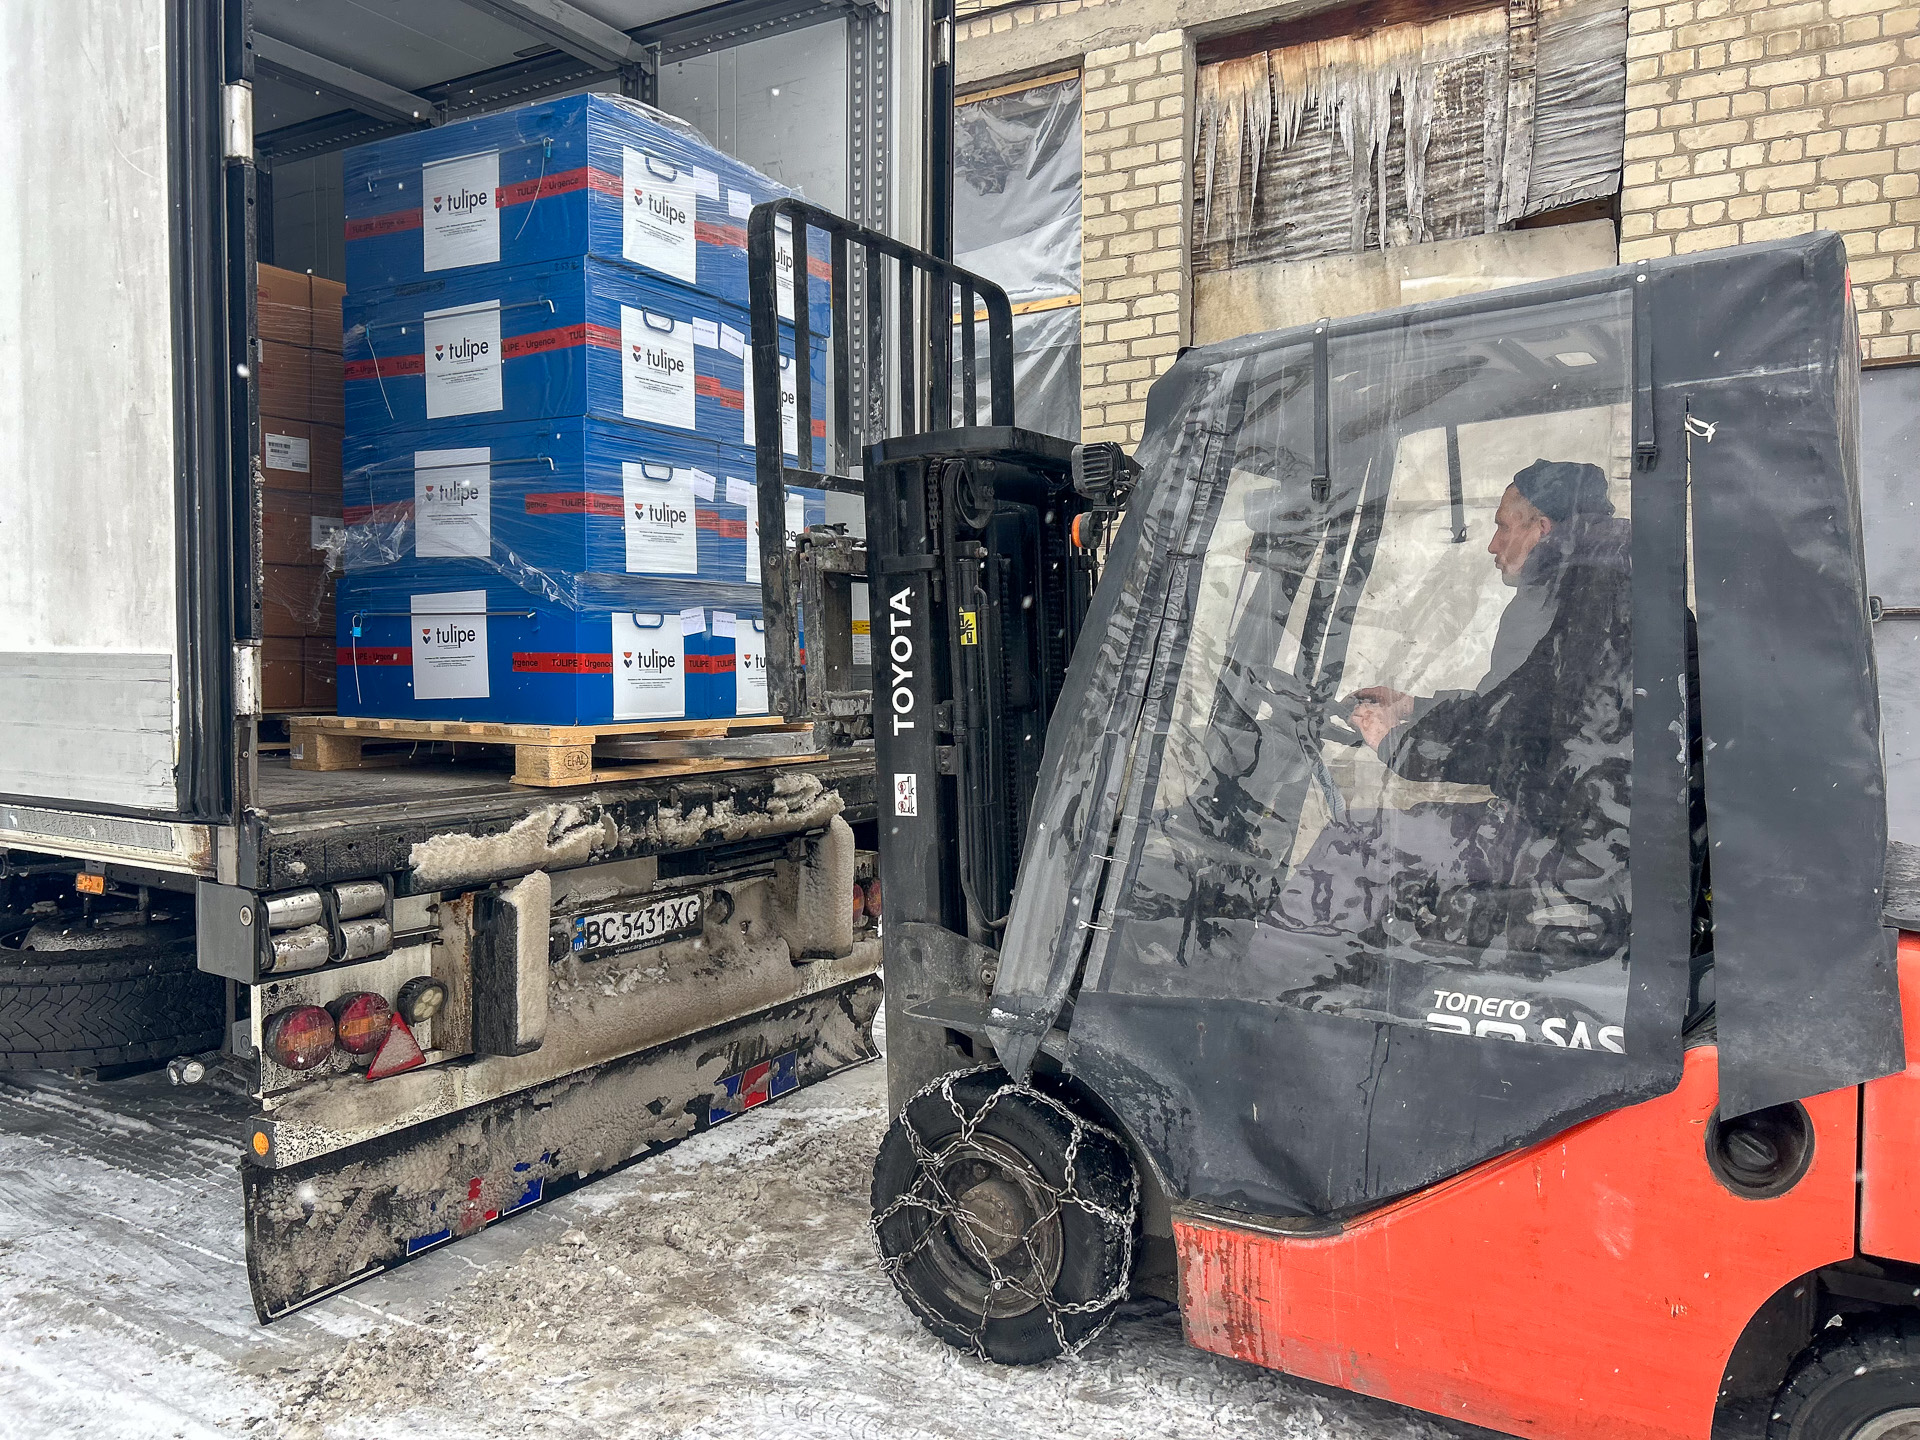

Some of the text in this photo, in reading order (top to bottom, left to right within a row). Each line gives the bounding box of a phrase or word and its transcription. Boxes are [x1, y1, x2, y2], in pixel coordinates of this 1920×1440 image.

[548, 178, 579, 191] Urgence
[447, 188, 487, 213] tulipe
[648, 194, 686, 226] tulipe
[449, 337, 489, 362] tulipe
[526, 336, 556, 349] Urgence
[396, 360, 419, 370] TULIPE
[647, 348, 685, 376] tulipe
[439, 480, 479, 506] tulipe
[561, 498, 587, 507] TULIPE
[649, 501, 687, 528] tulipe
[436, 623, 476, 648] tulipe
[552, 658, 578, 667] TULIPE
[638, 648, 676, 674] tulipe
[689, 660, 709, 668] TULIPE
[716, 659, 736, 668] TULIPE
[889, 586, 915, 736] TOYOTA
[586, 917, 616, 949] BC
[621, 906, 665, 940] 5431
[574, 941, 583, 951] UA
